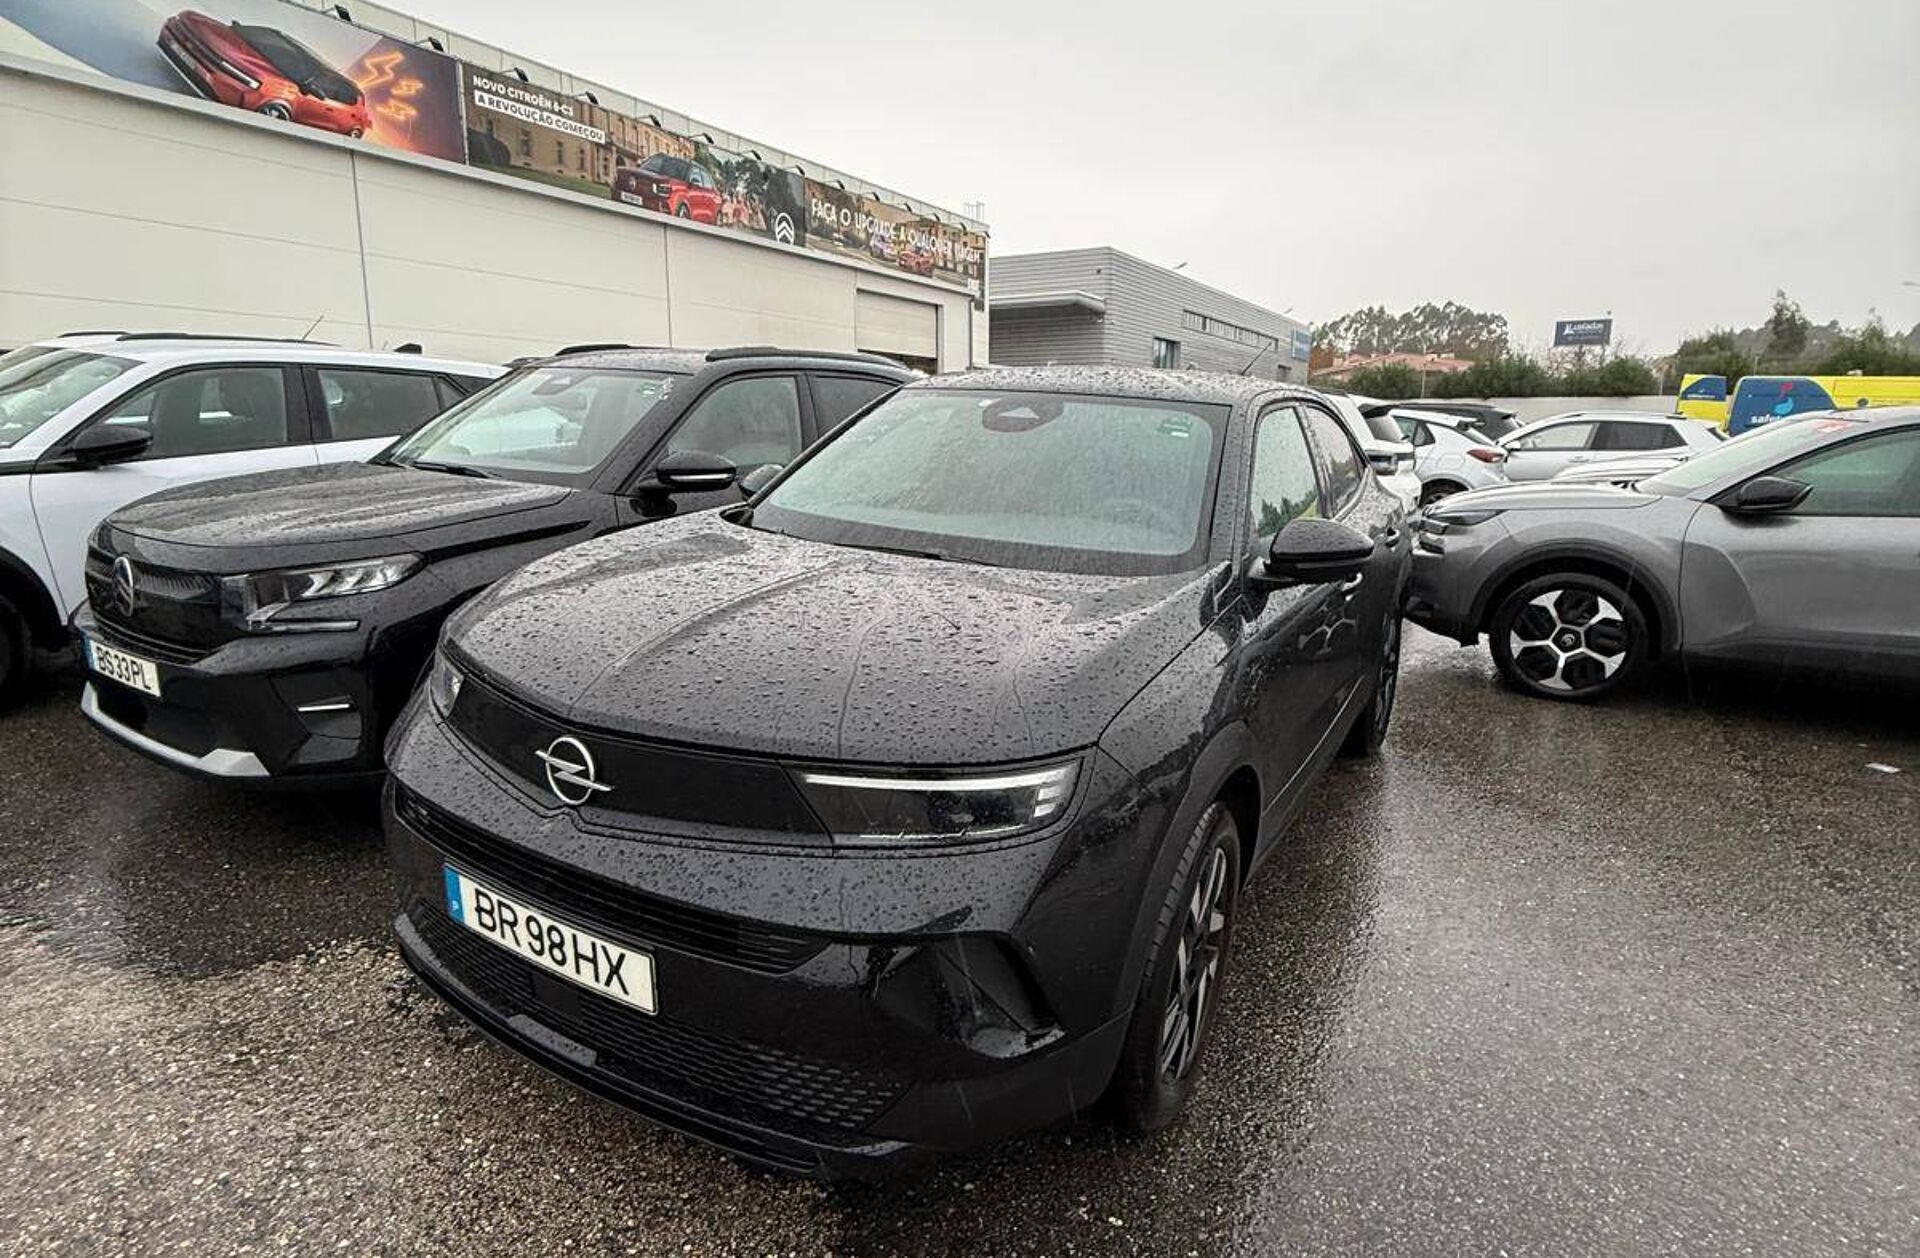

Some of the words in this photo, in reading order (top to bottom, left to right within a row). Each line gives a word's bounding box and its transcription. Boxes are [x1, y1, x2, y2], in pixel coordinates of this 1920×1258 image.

[473, 75, 506, 94] NOVO
[507, 88, 552, 111] CITROËN
[477, 93, 487, 105] A
[487, 96, 553, 126] REVOLUÇÃO
[554, 119, 603, 140] COMEÇOU
[811, 198, 837, 223] FAÇA
[840, 208, 851, 226] O
[854, 212, 896, 240] UPGRADE
[96, 646, 151, 690] BS33PL
[474, 888, 521, 948] BR
[525, 915, 567, 966] 98
[571, 933, 630, 996] HX
